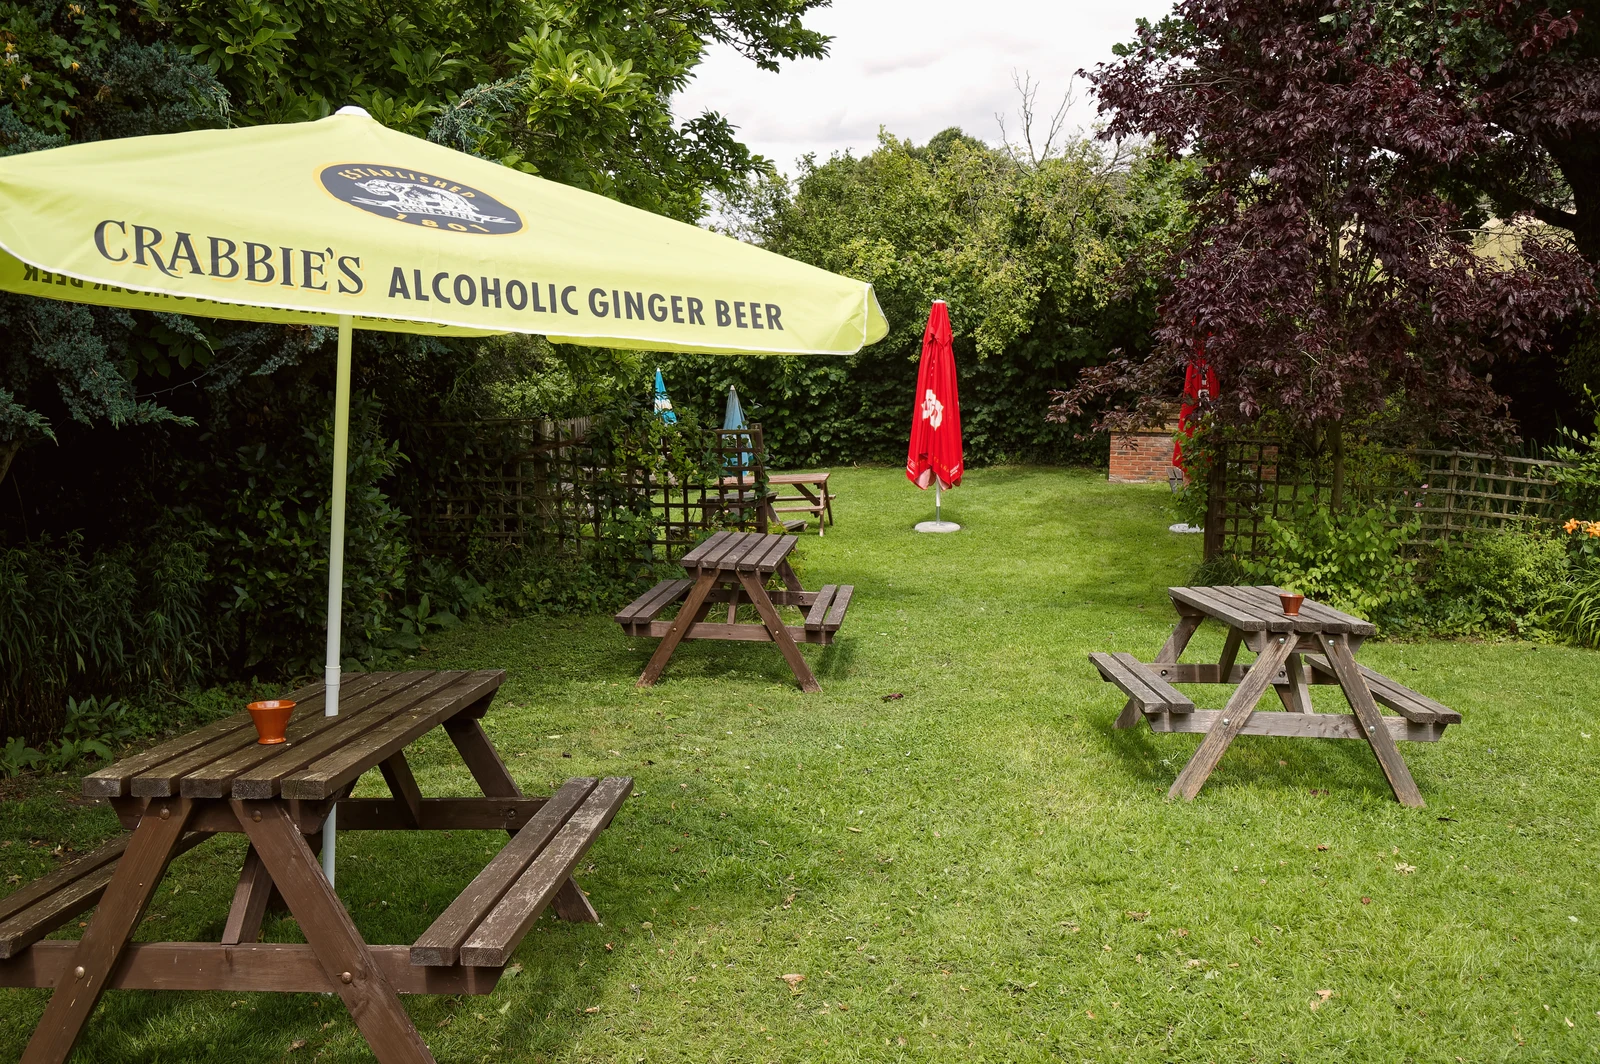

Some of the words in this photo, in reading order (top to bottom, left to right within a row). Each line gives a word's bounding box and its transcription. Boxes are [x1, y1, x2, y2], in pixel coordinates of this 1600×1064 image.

[338, 168, 476, 198] ESTABLISHED
[396, 213, 490, 232] 1801
[94, 219, 364, 295] CRABBIE'S
[388, 267, 578, 316] ALCOHOLIC
[588, 287, 705, 326] GINGER
[715, 299, 784, 331] BEER
